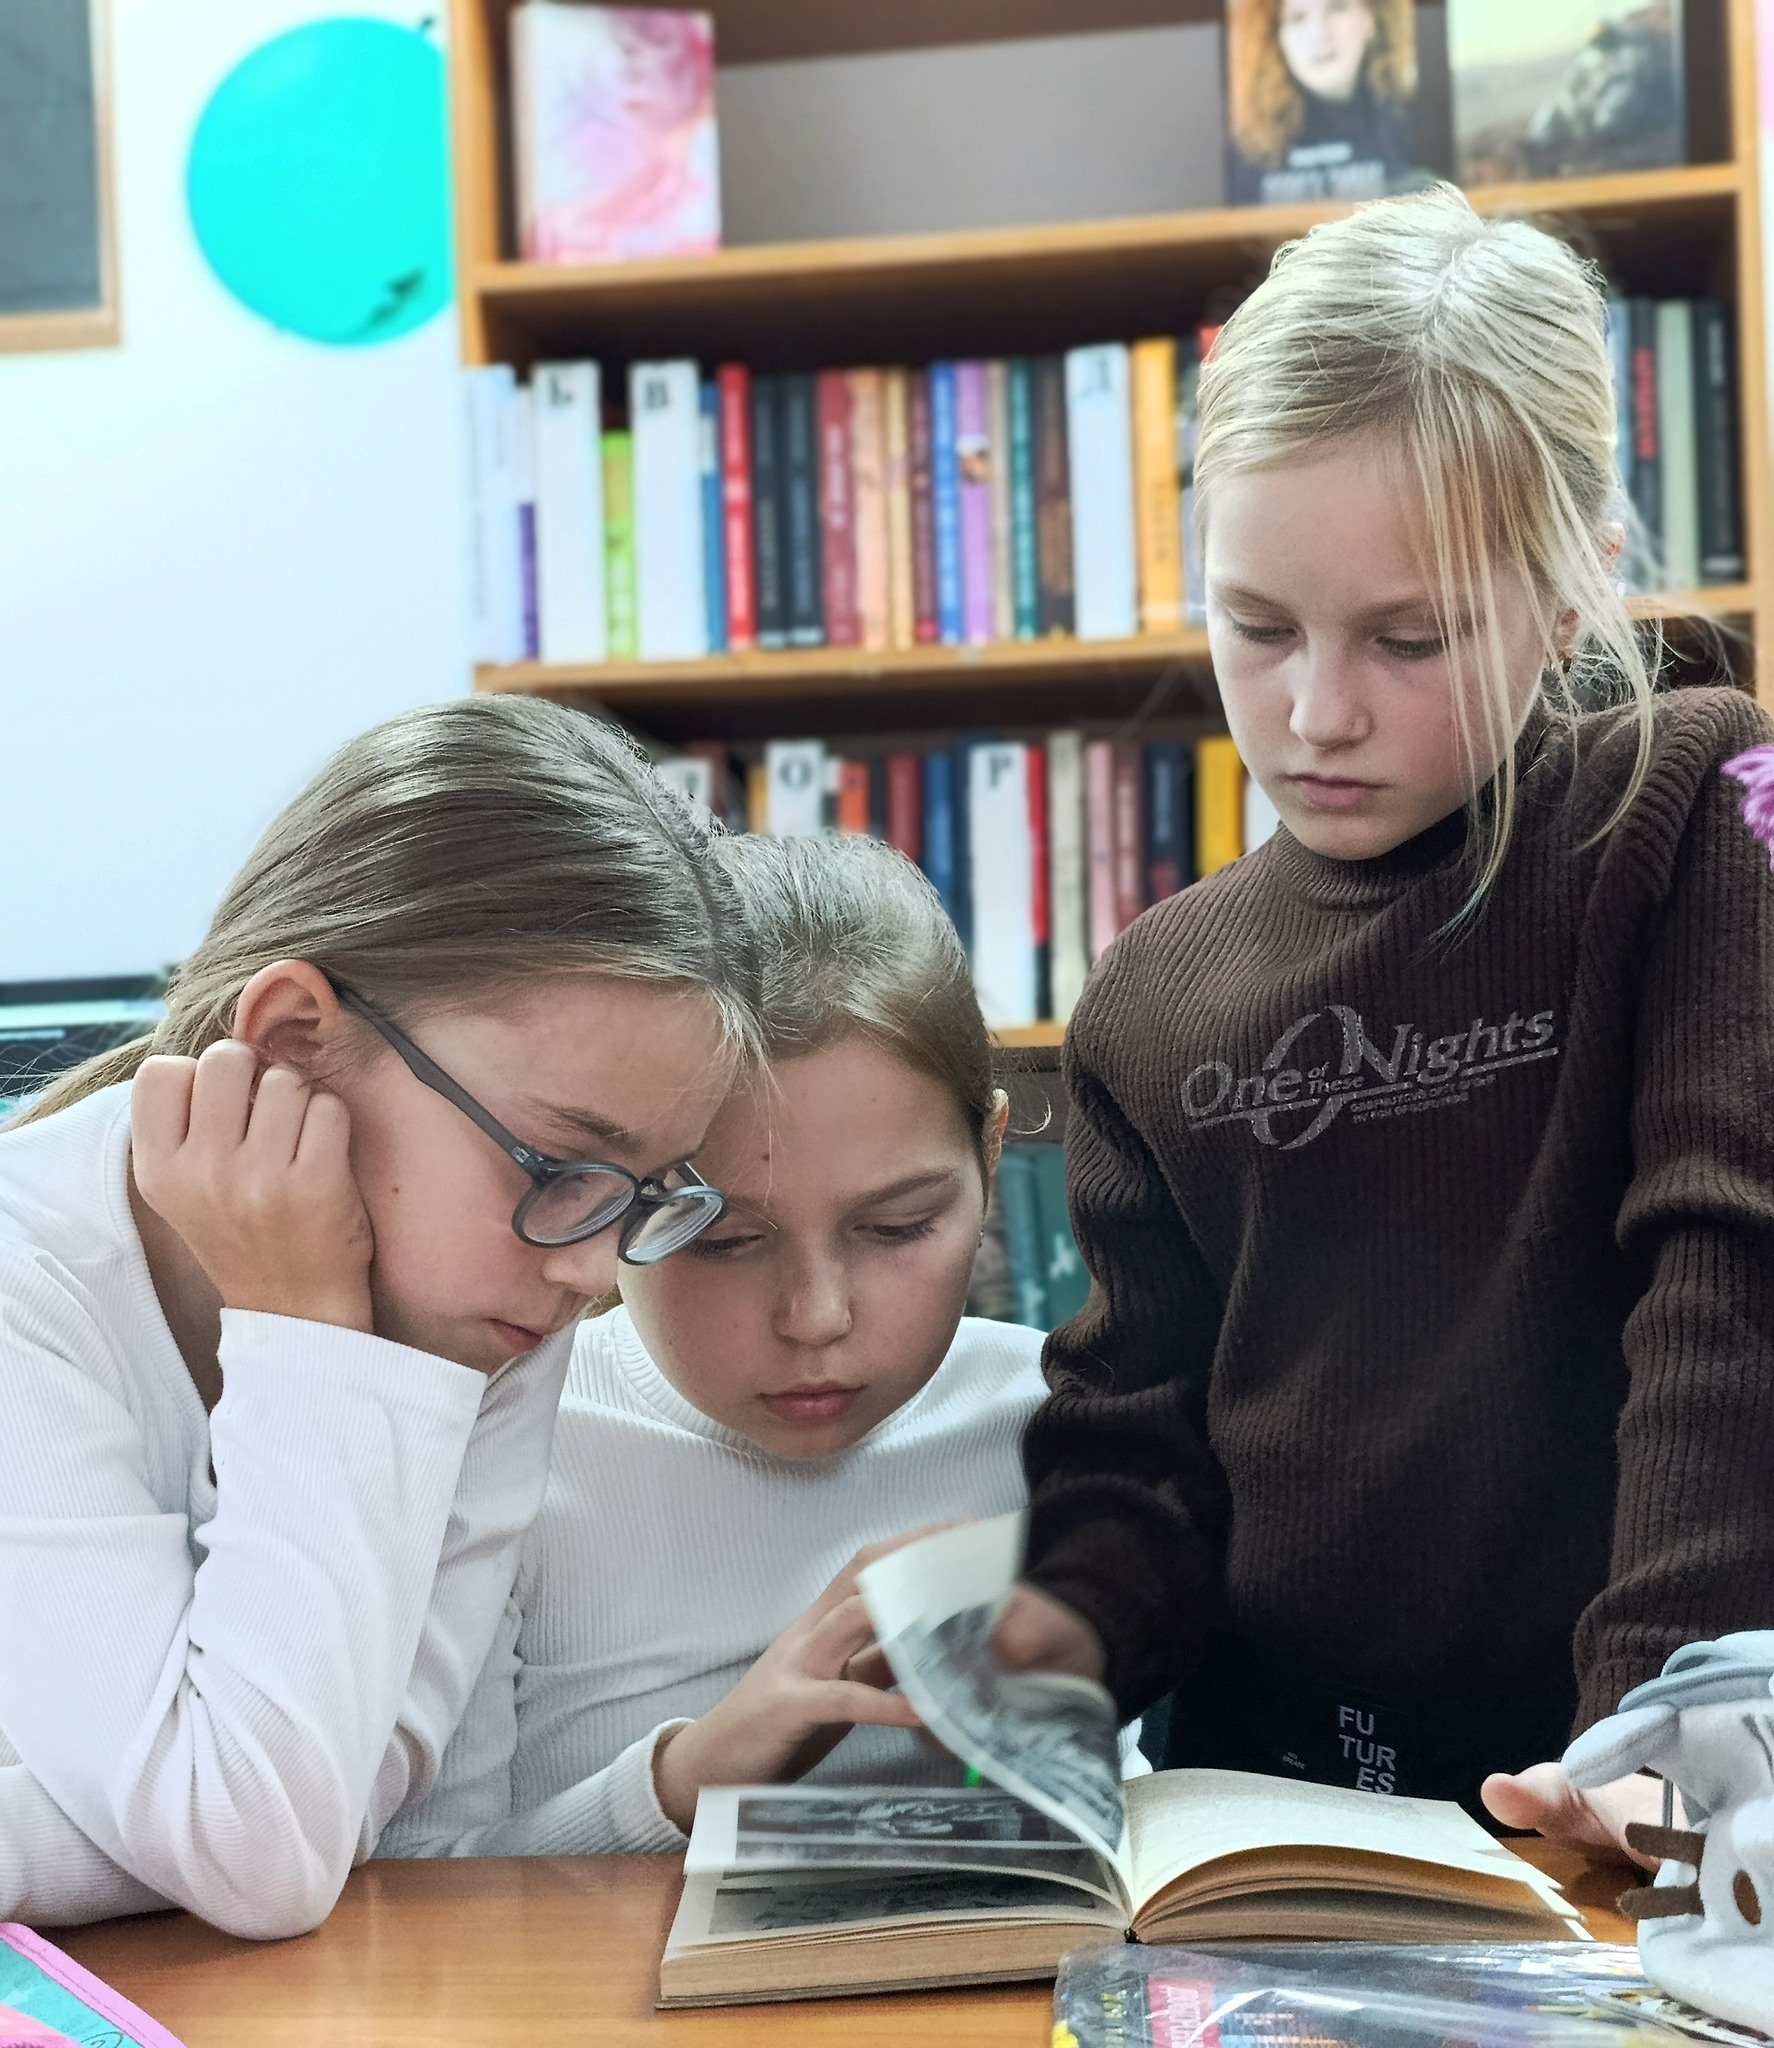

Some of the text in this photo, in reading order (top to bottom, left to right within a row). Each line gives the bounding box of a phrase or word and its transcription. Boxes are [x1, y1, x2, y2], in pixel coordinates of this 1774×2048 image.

[1325, 1004, 1555, 1085] Nights
[1308, 1062, 1330, 1079] of
[1308, 1074, 1364, 1096] These
[1180, 1061, 1302, 1118] One
[1338, 1705, 1375, 1736] FU
[1338, 1733, 1396, 1772] TUR
[1356, 1767, 1396, 1795] ES
